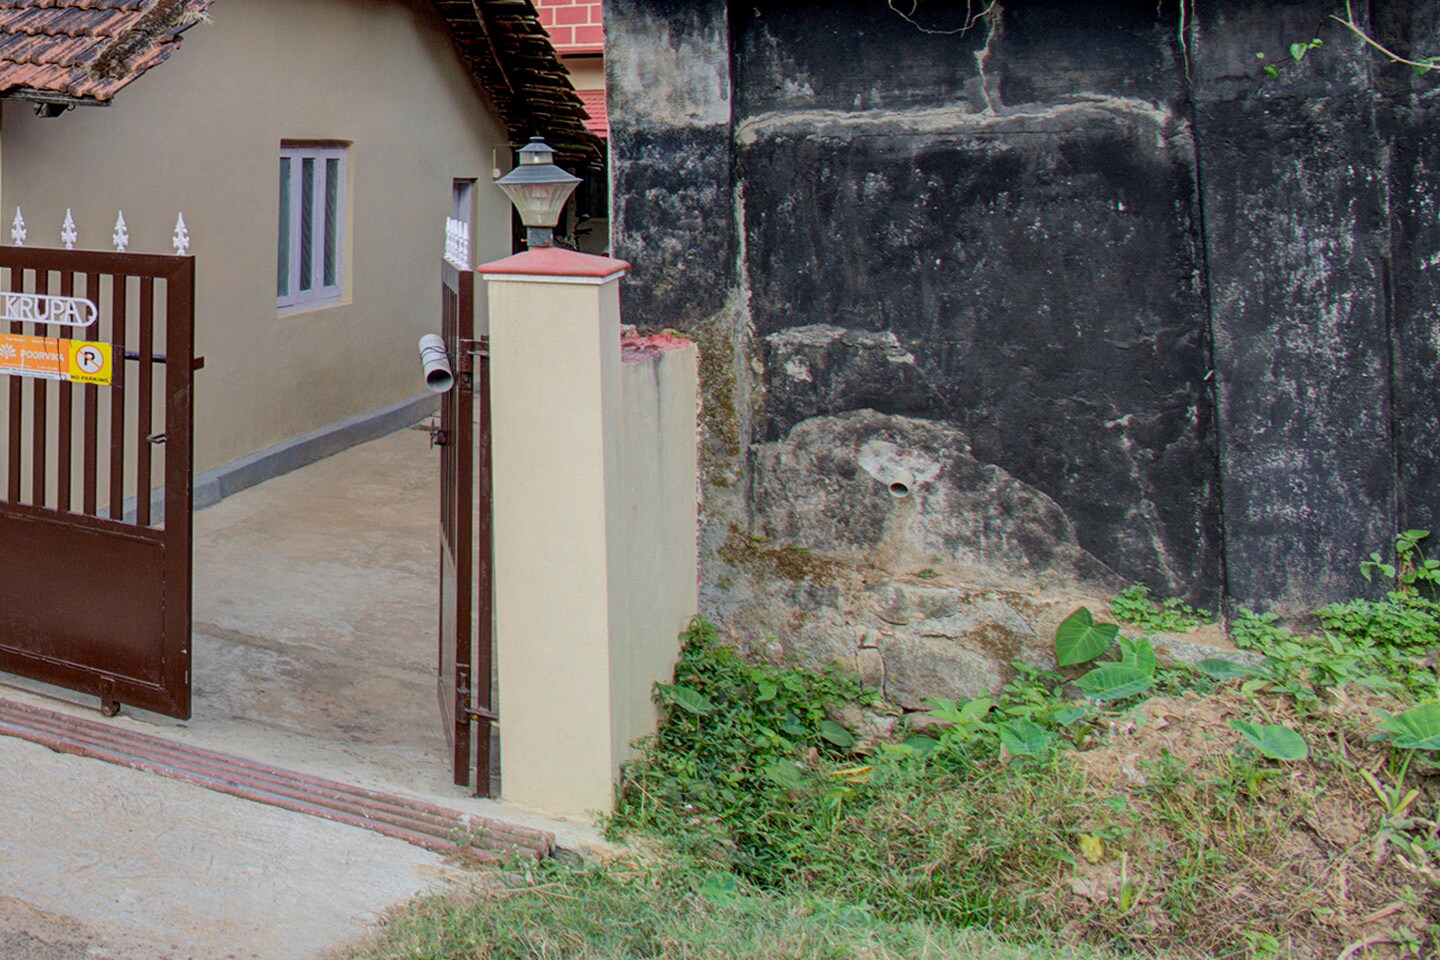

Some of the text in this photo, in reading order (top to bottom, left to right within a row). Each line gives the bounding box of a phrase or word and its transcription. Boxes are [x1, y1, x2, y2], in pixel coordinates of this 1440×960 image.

[5, 295, 83, 324] KRUPA
[21, 349, 64, 361] POORVIKA
[84, 351, 95, 366] P
[81, 375, 109, 383] PARKING
